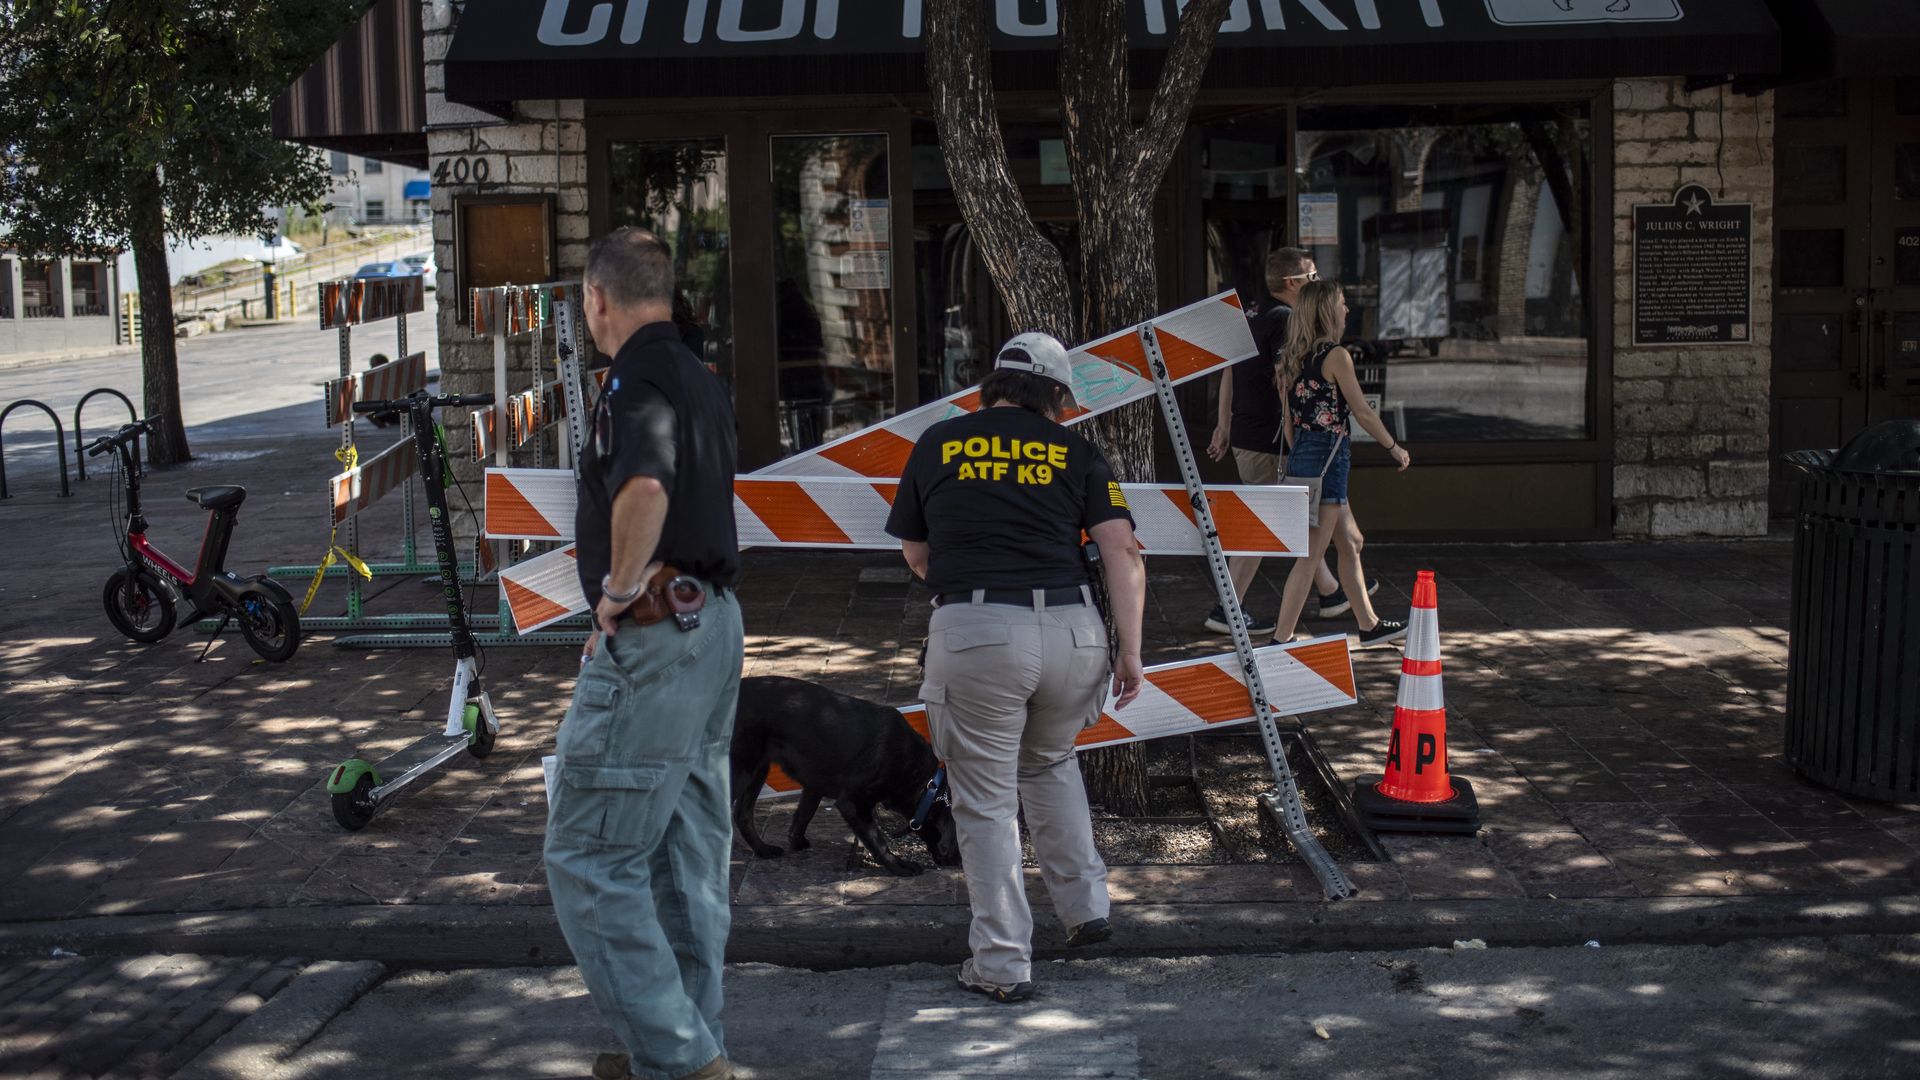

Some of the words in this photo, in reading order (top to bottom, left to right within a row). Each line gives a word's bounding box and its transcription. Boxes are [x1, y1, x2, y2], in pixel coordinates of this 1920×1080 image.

[434, 157, 489, 183] 400
[1645, 221, 1682, 231] JULIUS
[1685, 221, 1696, 230] C.
[1699, 220, 1741, 230] WRIGHT
[1899, 236, 1920, 246] 402
[941, 435, 1069, 470] POLICE
[957, 461, 1009, 481] ATF
[1017, 464, 1053, 486] K9
[142, 554, 178, 586] WHEELS
